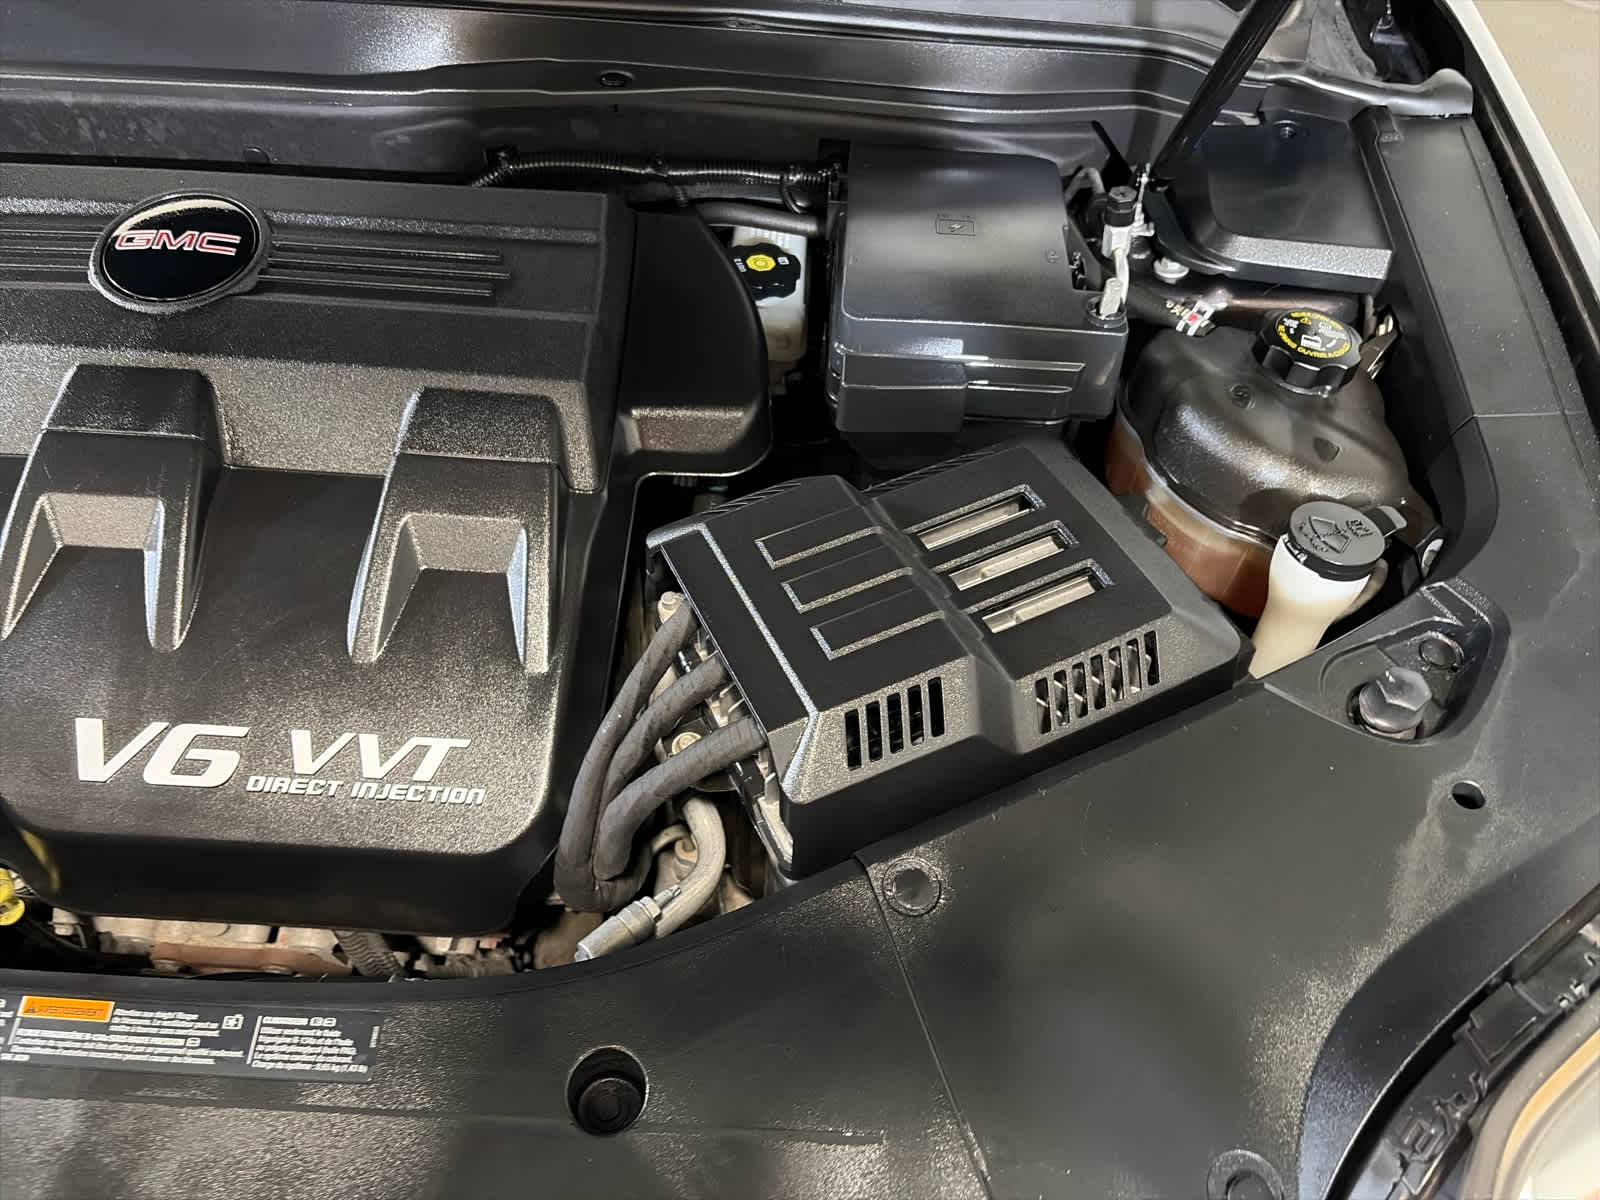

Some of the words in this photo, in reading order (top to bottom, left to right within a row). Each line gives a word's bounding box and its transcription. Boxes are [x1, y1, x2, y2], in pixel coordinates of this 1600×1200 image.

[115, 230, 241, 256] GMC
[75, 717, 250, 788] V6
[290, 729, 472, 782] VVT
[246, 776, 343, 798] DIRECT
[351, 781, 486, 806] INJECTION
